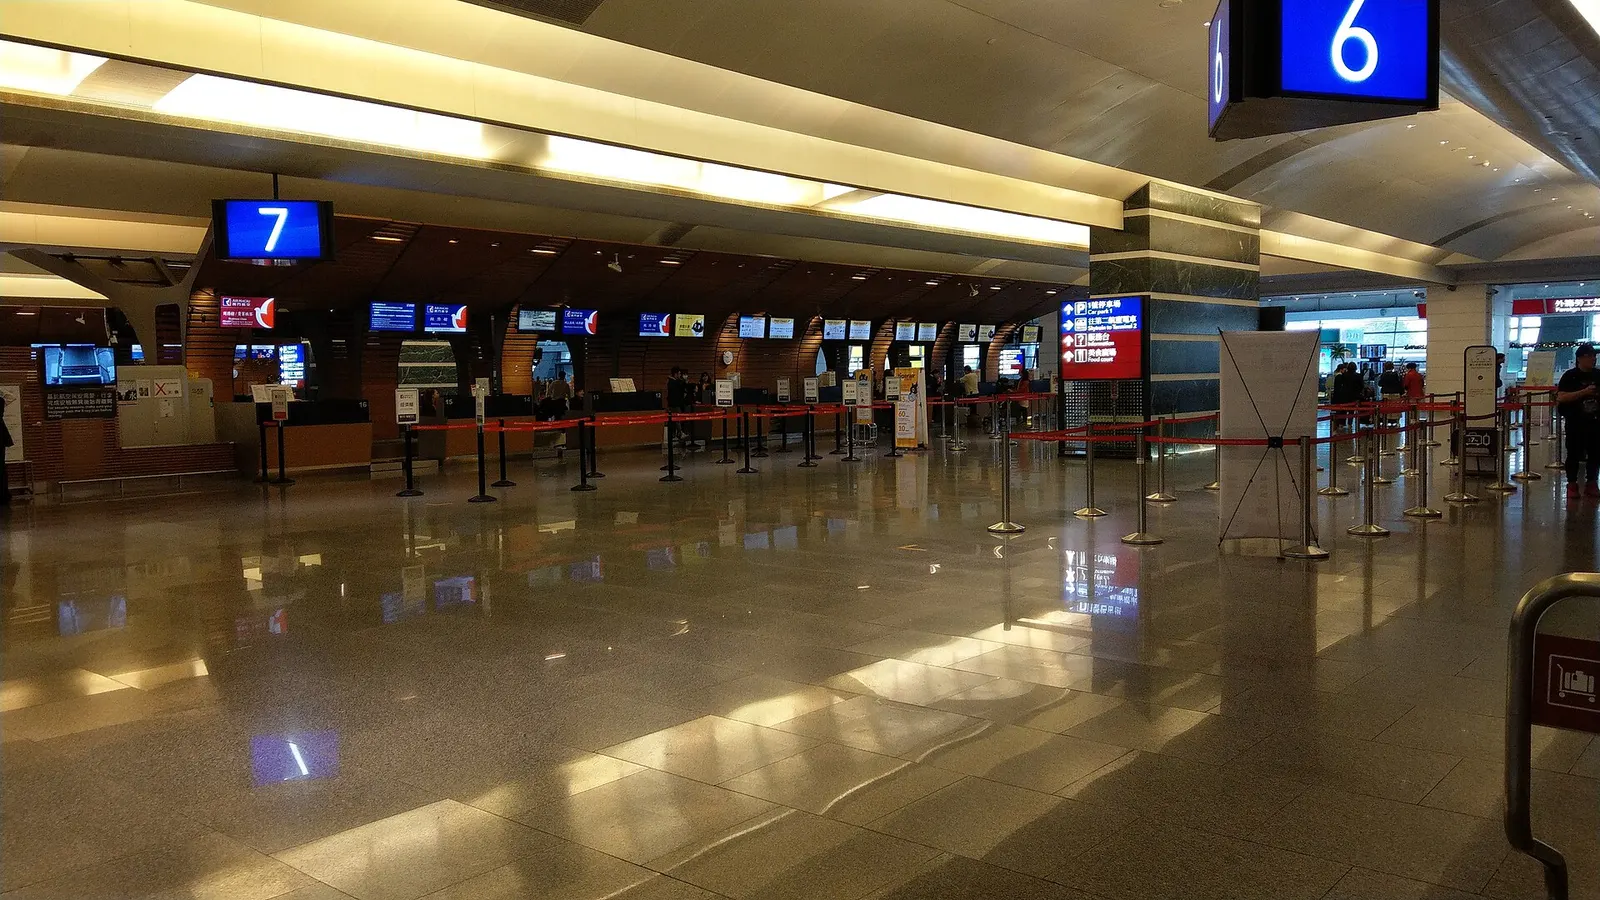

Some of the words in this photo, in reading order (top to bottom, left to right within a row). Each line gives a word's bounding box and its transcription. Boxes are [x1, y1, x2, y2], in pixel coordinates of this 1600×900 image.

[1215, 19, 1223, 104] 6
[1331, 0, 1379, 83] 6
[258, 207, 289, 252] 7
